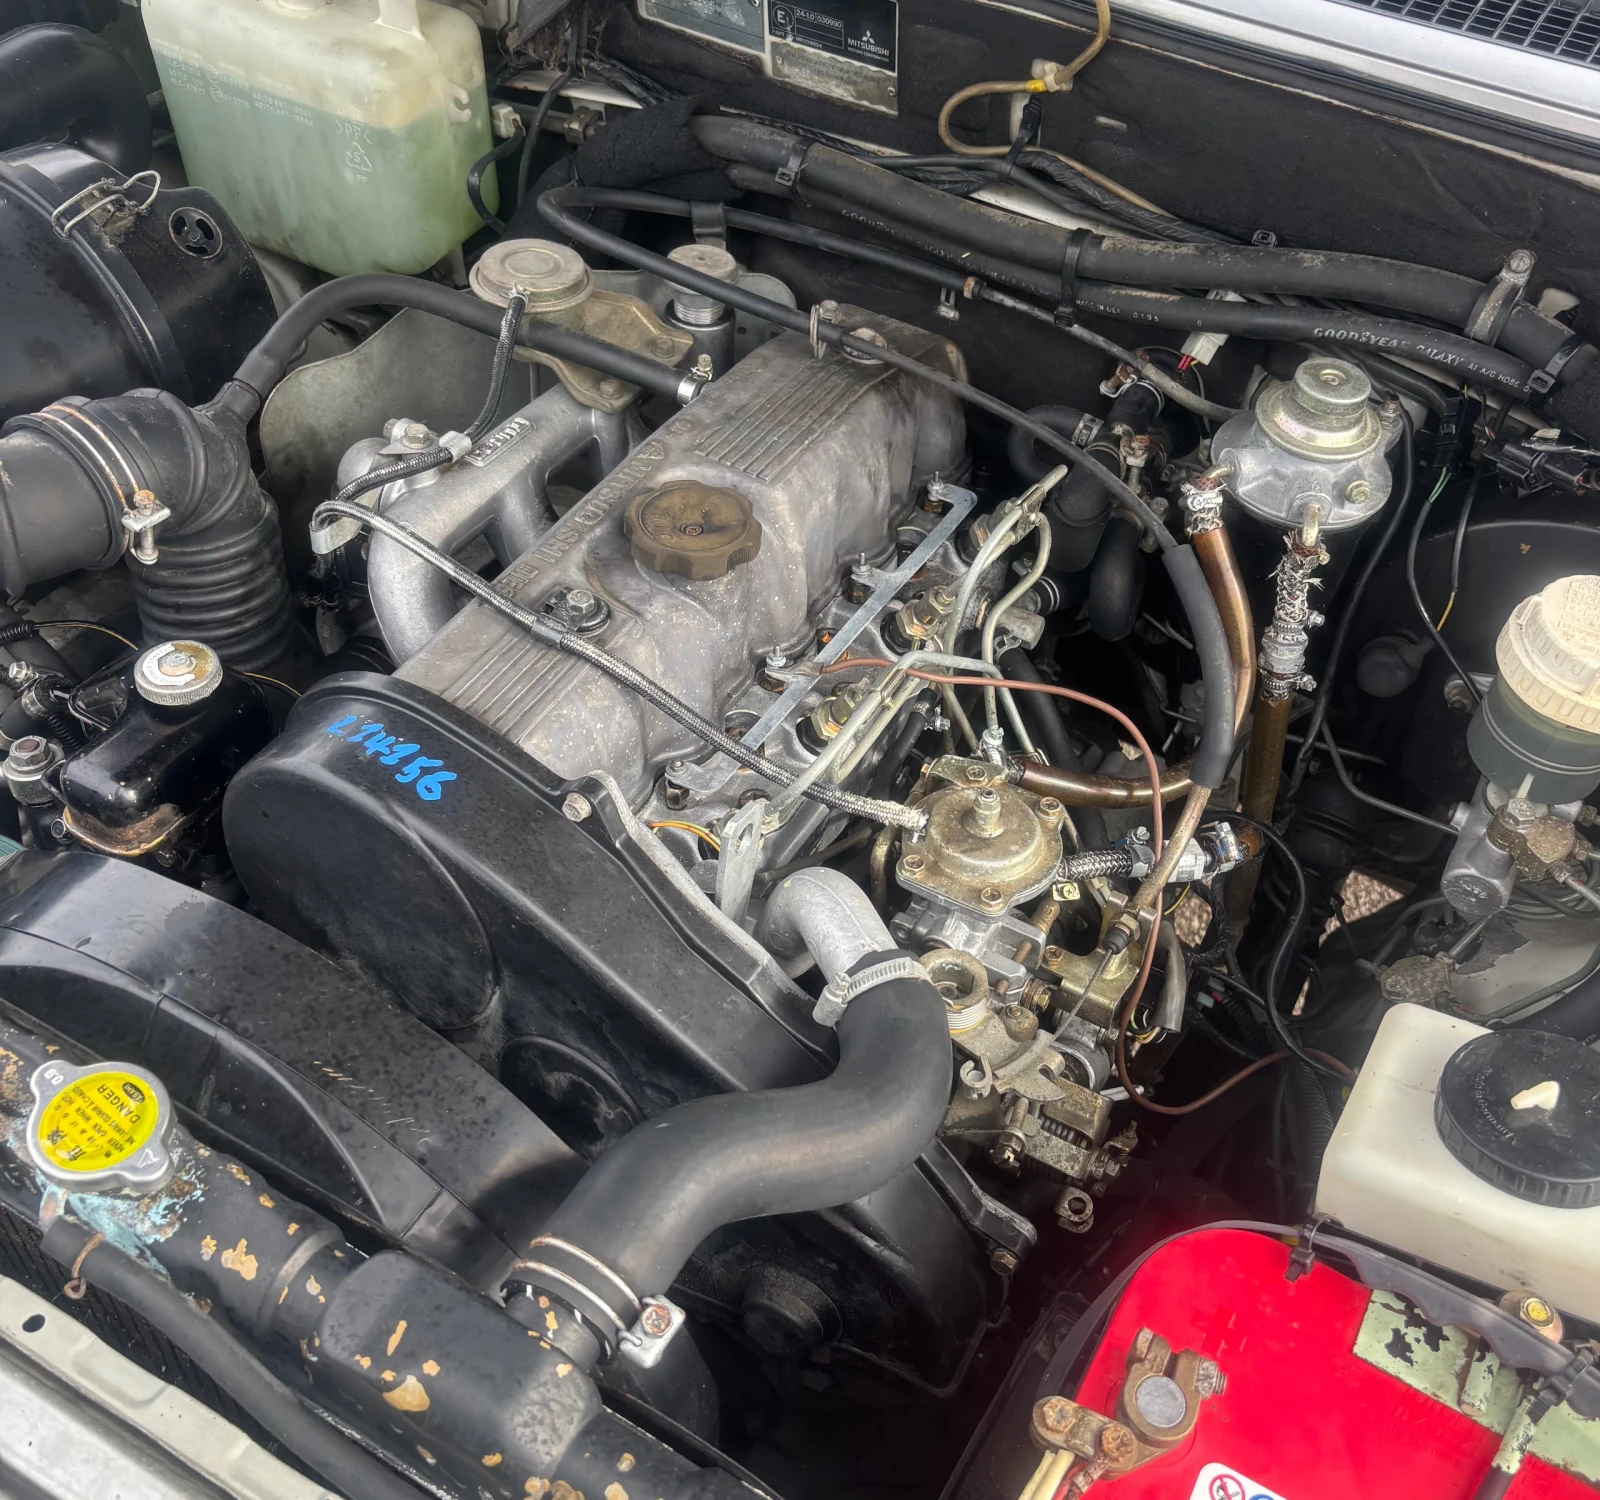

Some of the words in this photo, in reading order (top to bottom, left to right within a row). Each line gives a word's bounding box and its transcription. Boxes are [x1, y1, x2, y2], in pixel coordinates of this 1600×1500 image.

[817, 16, 842, 28] 030990
[848, 38, 890, 56] MITSUBISHI
[848, 47, 863, 55] MOTORS
[864, 52, 889, 63] CORPORATION
[1479, 367, 1496, 378] A/C
[1498, 373, 1521, 388] HOSE
[533, 457, 649, 565] MITSUBISHI
[124, 1083, 144, 1101] ASAHI
[96, 1084, 141, 1124] DANGER
[74, 1107, 92, 1123] WHEN
[92, 1104, 112, 1123] OUVRIR
[91, 1123, 108, 1137] OPEN
[108, 1120, 128, 1137] JAMAIS
[107, 1137, 125, 1153] NEVER
[126, 1136, 136, 1145] NE
